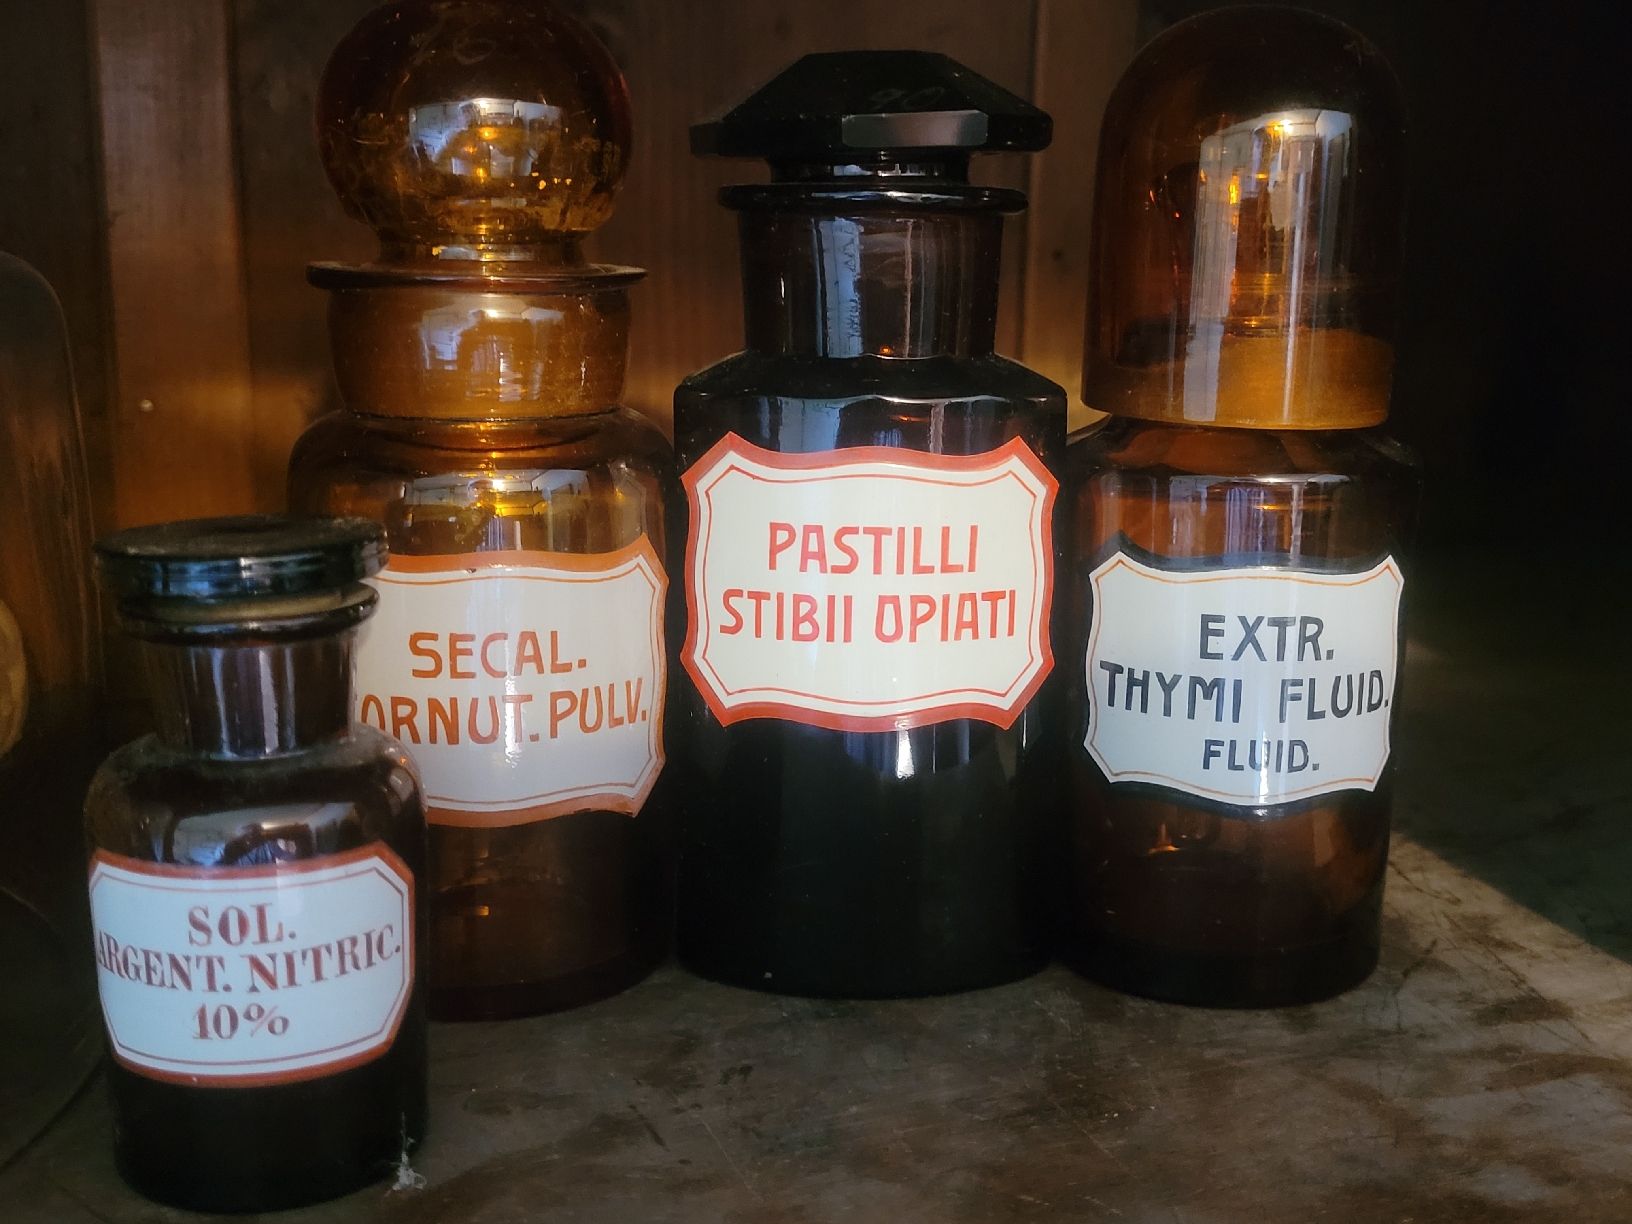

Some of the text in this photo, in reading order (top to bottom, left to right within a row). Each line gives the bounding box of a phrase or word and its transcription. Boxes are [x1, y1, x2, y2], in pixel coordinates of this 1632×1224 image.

[768, 522, 978, 575] PASTILLI
[720, 589, 1016, 643] STIBII OPIATI
[1200, 613, 1334, 662] EXTR.
[408, 630, 587, 679] SECAL.
[550, 677, 647, 739] PULV.
[1100, 660, 1389, 724] THYMI FLUID.
[1202, 739, 1320, 774] FLUID.
[187, 902, 296, 947] SOL.
[97, 923, 401, 993] ARGENT. NITRIC.
[192, 1002, 290, 1041] 10%
